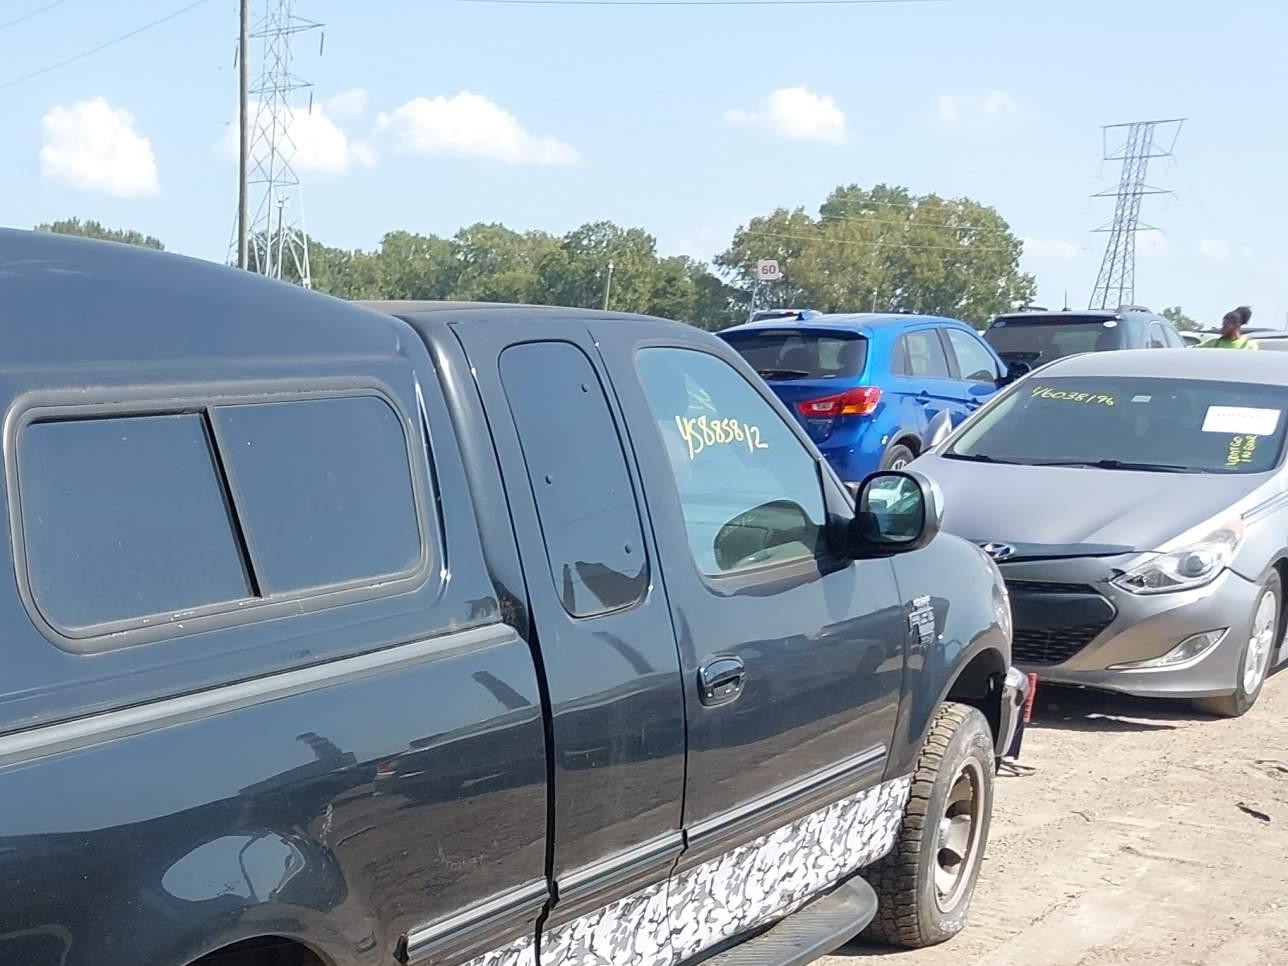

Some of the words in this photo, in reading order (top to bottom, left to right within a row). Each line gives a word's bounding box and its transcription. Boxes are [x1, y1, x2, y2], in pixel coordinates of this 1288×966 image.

[761, 264, 777, 275] 60
[1031, 386, 1115, 406] 46038196
[675, 415, 769, 461] 45885812
